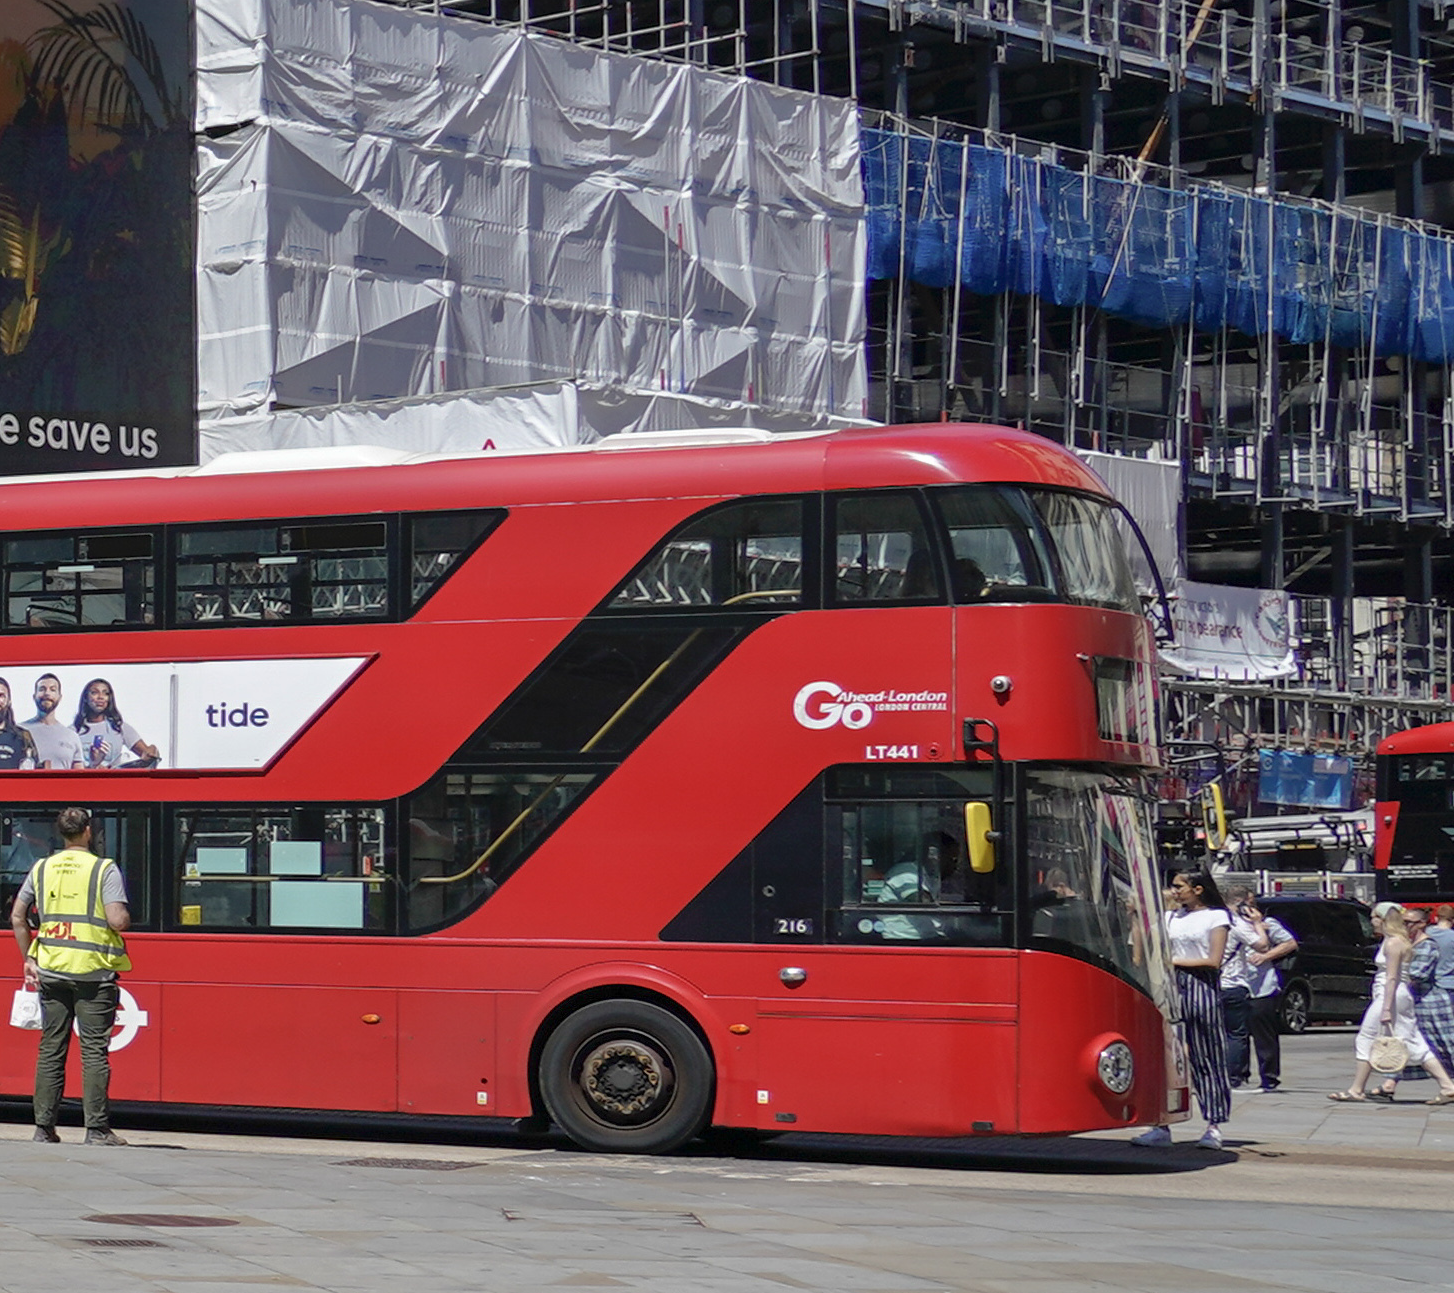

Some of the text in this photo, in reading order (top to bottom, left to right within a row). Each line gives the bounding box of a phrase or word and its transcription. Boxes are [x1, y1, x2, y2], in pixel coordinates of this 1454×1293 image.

[27, 414, 111, 458] save
[118, 421, 159, 460] us
[205, 700, 270, 729] tide
[875, 702, 947, 712] LONDON CENTRAL
[865, 744, 919, 759] LT441
[777, 917, 808, 935] 216
